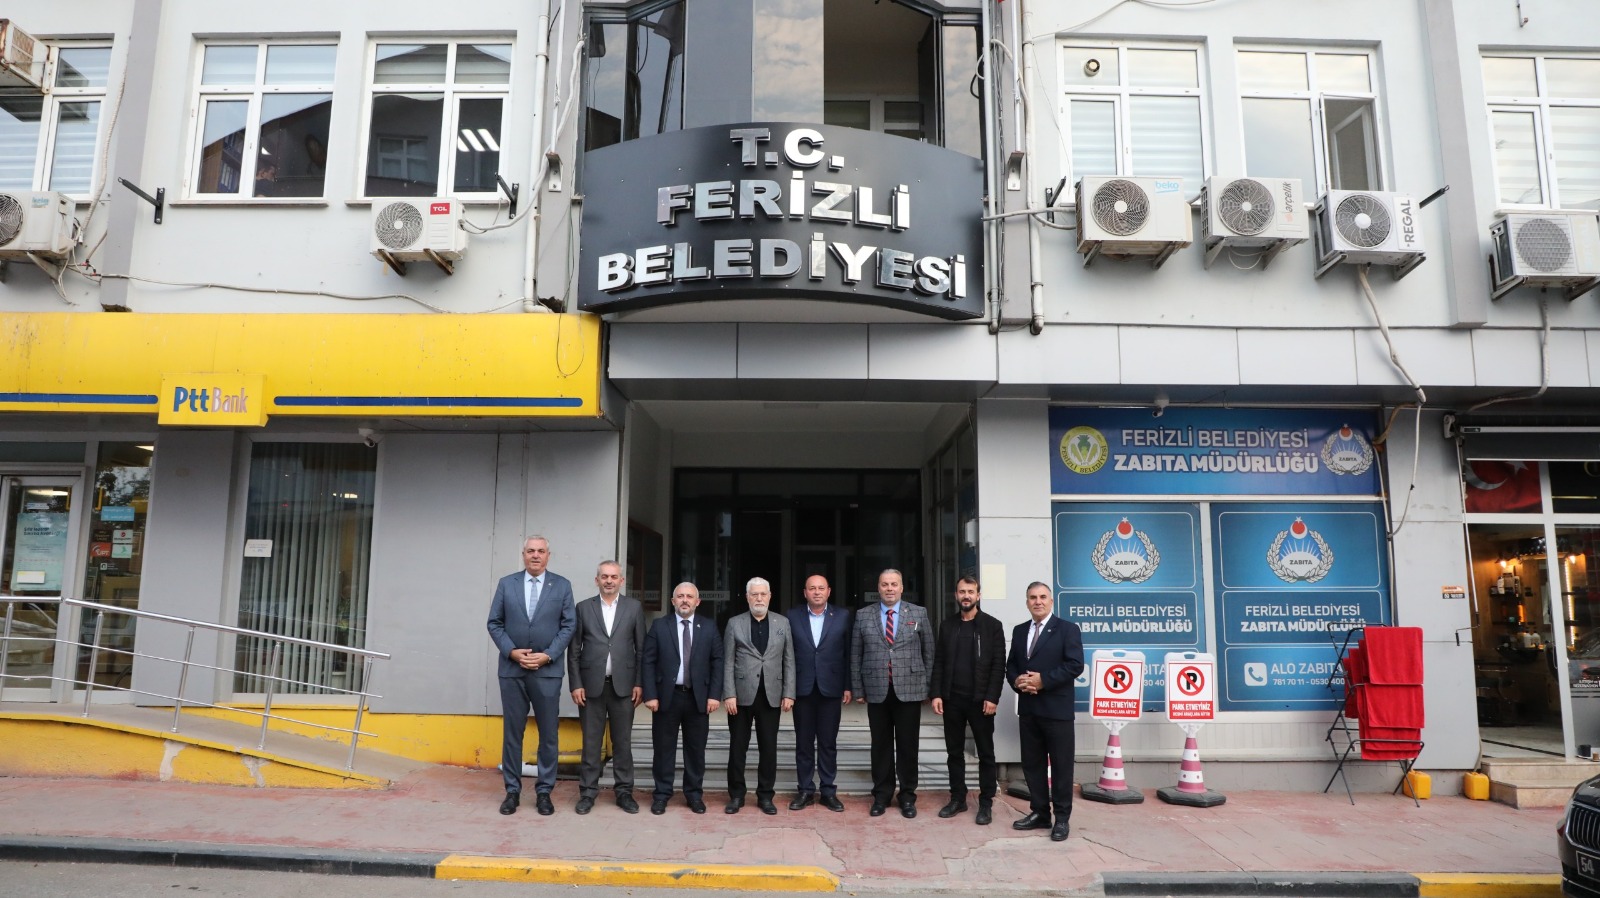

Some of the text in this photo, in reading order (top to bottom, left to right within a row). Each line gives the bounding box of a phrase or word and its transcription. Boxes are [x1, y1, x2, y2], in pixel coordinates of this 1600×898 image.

[730, 127, 845, 170] T.C.
[1155, 181, 1179, 189] beko
[656, 170, 910, 231] FERİZLİ
[1282, 182, 1294, 212] arçelik
[1400, 199, 1415, 243] REGAL
[598, 232, 967, 299] BELEDİYESİ
[1122, 426, 1308, 448] FERİZLİ BELEDİYESİ
[1114, 451, 1318, 474] ZABITA MÜDÜRLÜĞÜ
[1069, 604, 1187, 617] FERİZLİ BELEDİYESİ
[1245, 603, 1360, 616] FERİZLİ BELEDİYESİ
[1112, 619, 1193, 632] MÜDÜRLÜĞÜ
[1241, 621, 1287, 632] ZABITA
[1270, 662, 1343, 674] ALO ZABITA
[1111, 700, 1137, 708] ETMEYİNİZ
[1186, 702, 1211, 710] ETMEYİNİZ
[1581, 856, 1594, 875] 54
